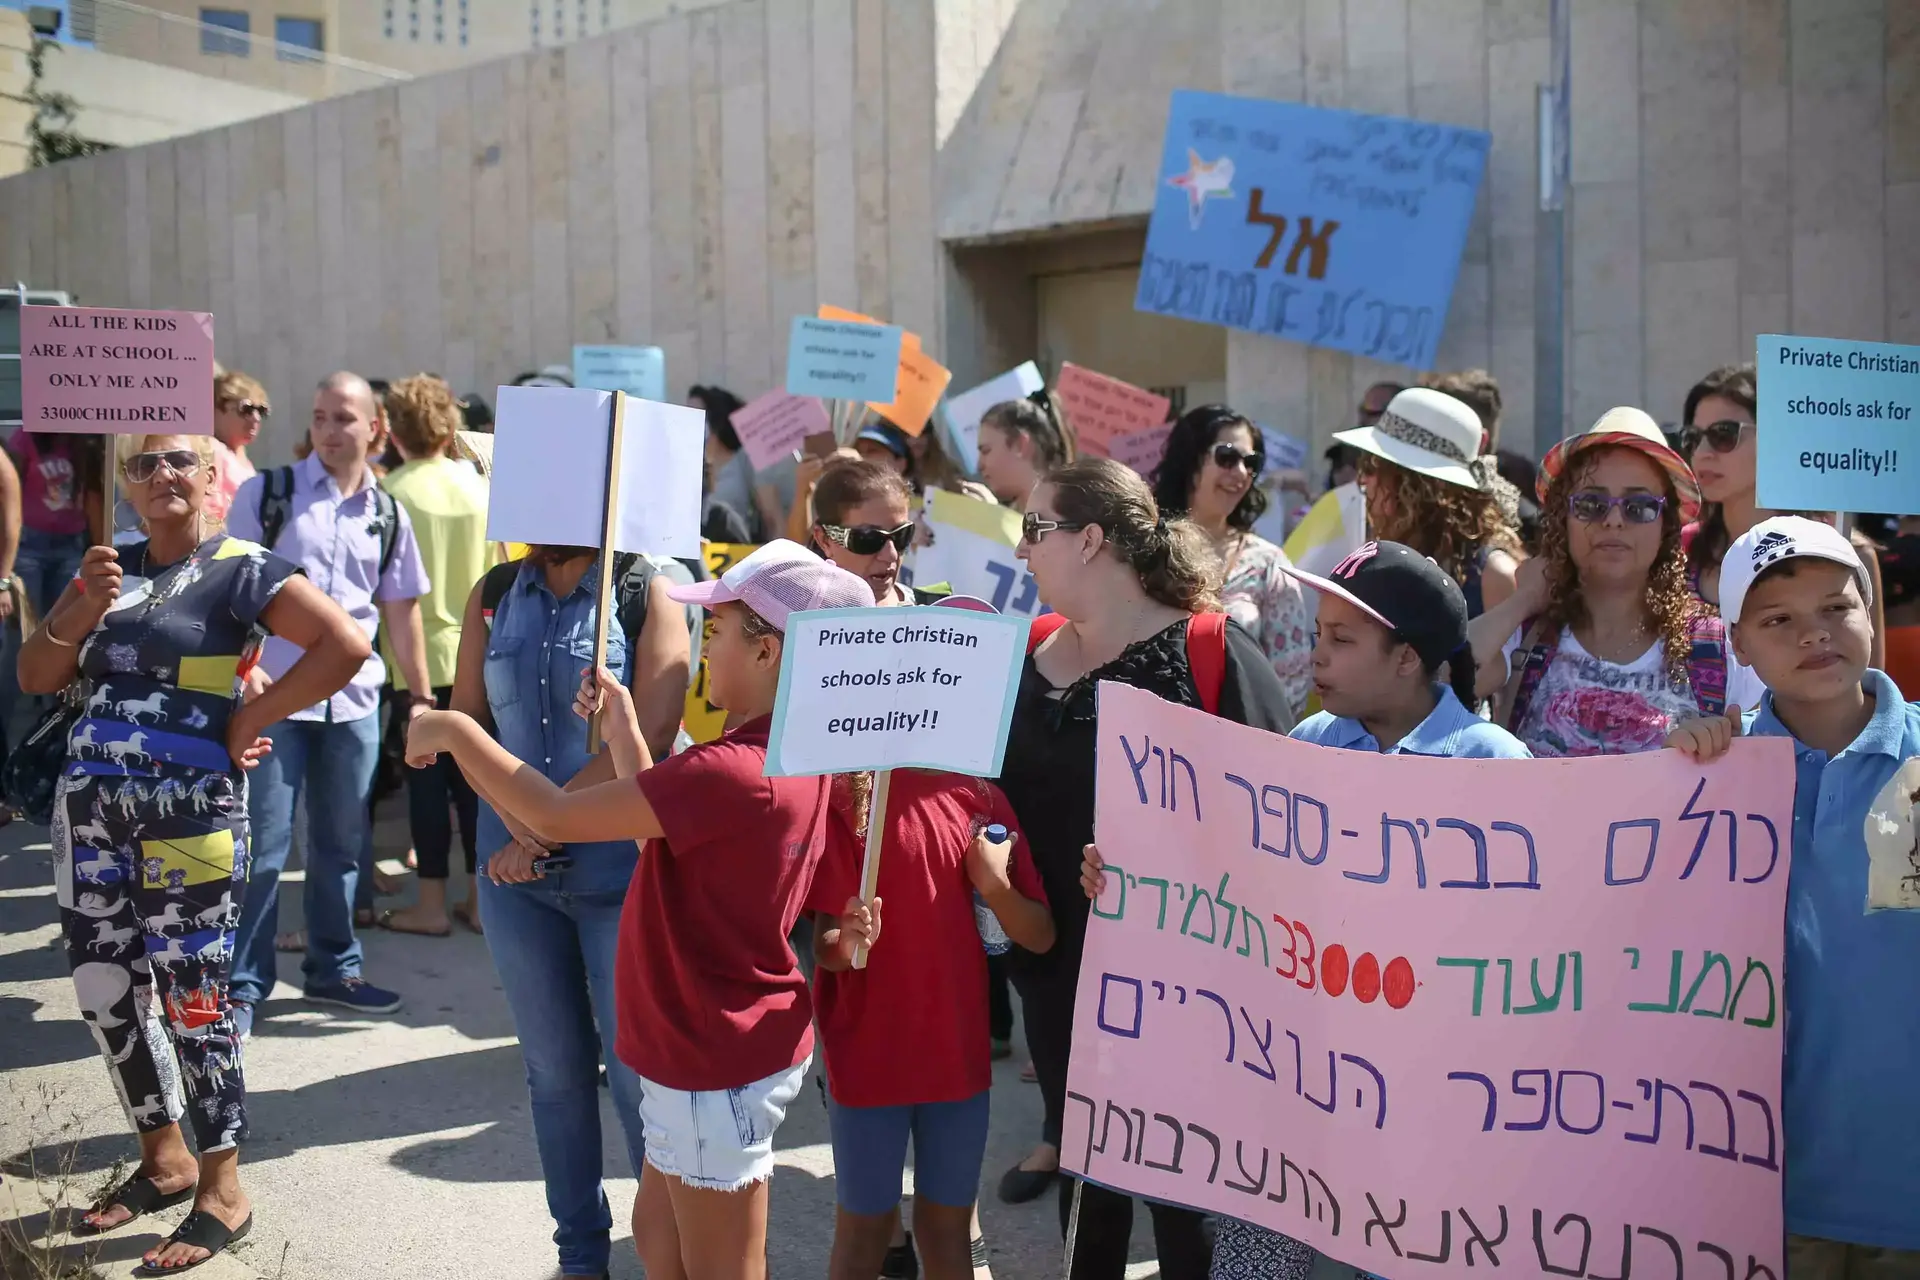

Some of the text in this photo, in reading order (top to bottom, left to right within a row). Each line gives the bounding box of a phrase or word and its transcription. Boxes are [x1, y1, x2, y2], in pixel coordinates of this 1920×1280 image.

[1246, 188, 1341, 280] אל
[48, 315, 177, 331] ALL THE KIDS
[29, 344, 67, 357] ARE
[72, 345, 97, 358] AT
[102, 346, 179, 360] SCHOOL
[1780, 346, 1919, 374] Private Christian
[49, 373, 178, 389] ONLY ME AND
[1787, 395, 1912, 421] schools ask for
[1799, 447, 1897, 477] equality!!
[818, 625, 978, 648] Private Christian
[821, 666, 962, 689] schools ask for
[827, 709, 939, 737] equality!!
[1119, 735, 1779, 889] כולם בבית-ספר חוץ
[1436, 951, 1583, 1017] ועוד
[1623, 947, 1776, 1028] ממני
[1097, 972, 1780, 1173] בבתי-ספר הנוצריים
[1066, 1090, 1341, 1237] התערבותך
[1364, 1192, 1509, 1268] אנא
